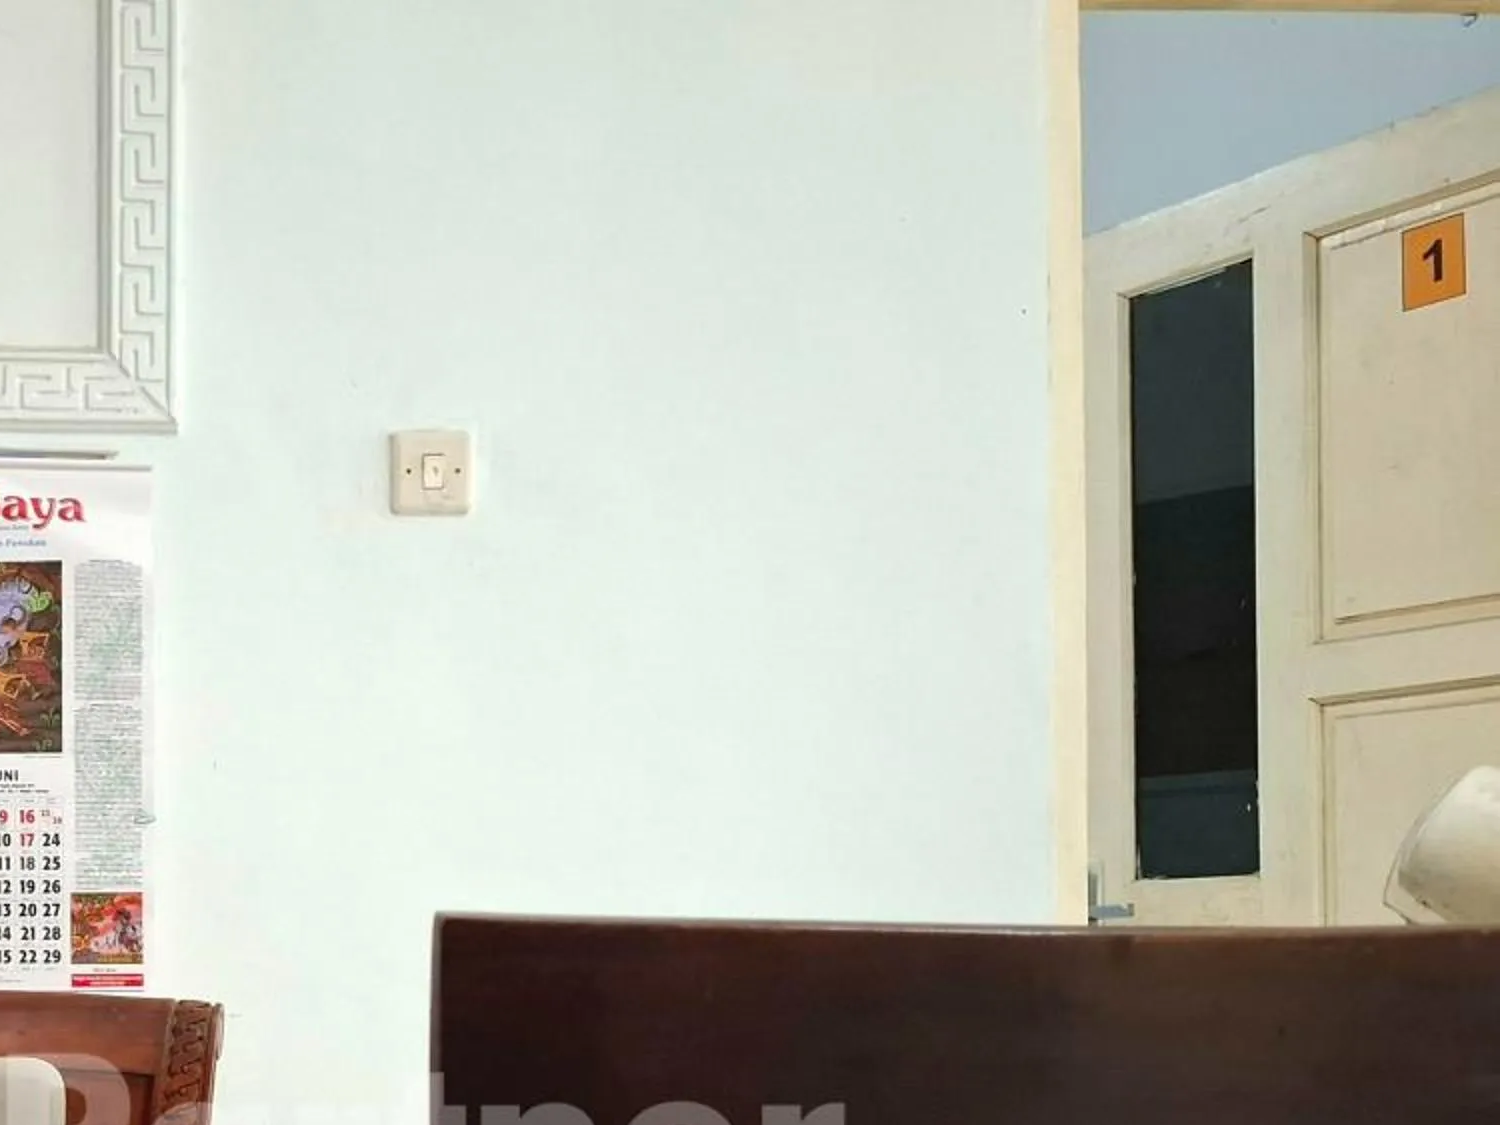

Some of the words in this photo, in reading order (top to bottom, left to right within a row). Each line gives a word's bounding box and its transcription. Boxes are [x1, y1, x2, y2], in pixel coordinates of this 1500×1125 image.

[1422, 238, 1443, 282] 1
[0, 810, 8, 824] 9
[20, 810, 35, 824] 16
[20, 833, 35, 847] 17
[42, 833, 60, 847] 24
[20, 856, 35, 870] 18
[42, 856, 61, 870] 25
[20, 880, 35, 894] 19
[43, 880, 61, 894] 26
[19, 903, 37, 917] 20
[43, 903, 61, 917] 27
[21, 926, 35, 940] 21
[43, 926, 61, 940] 28
[19, 950, 37, 963] 22
[43, 950, 62, 963] 29
